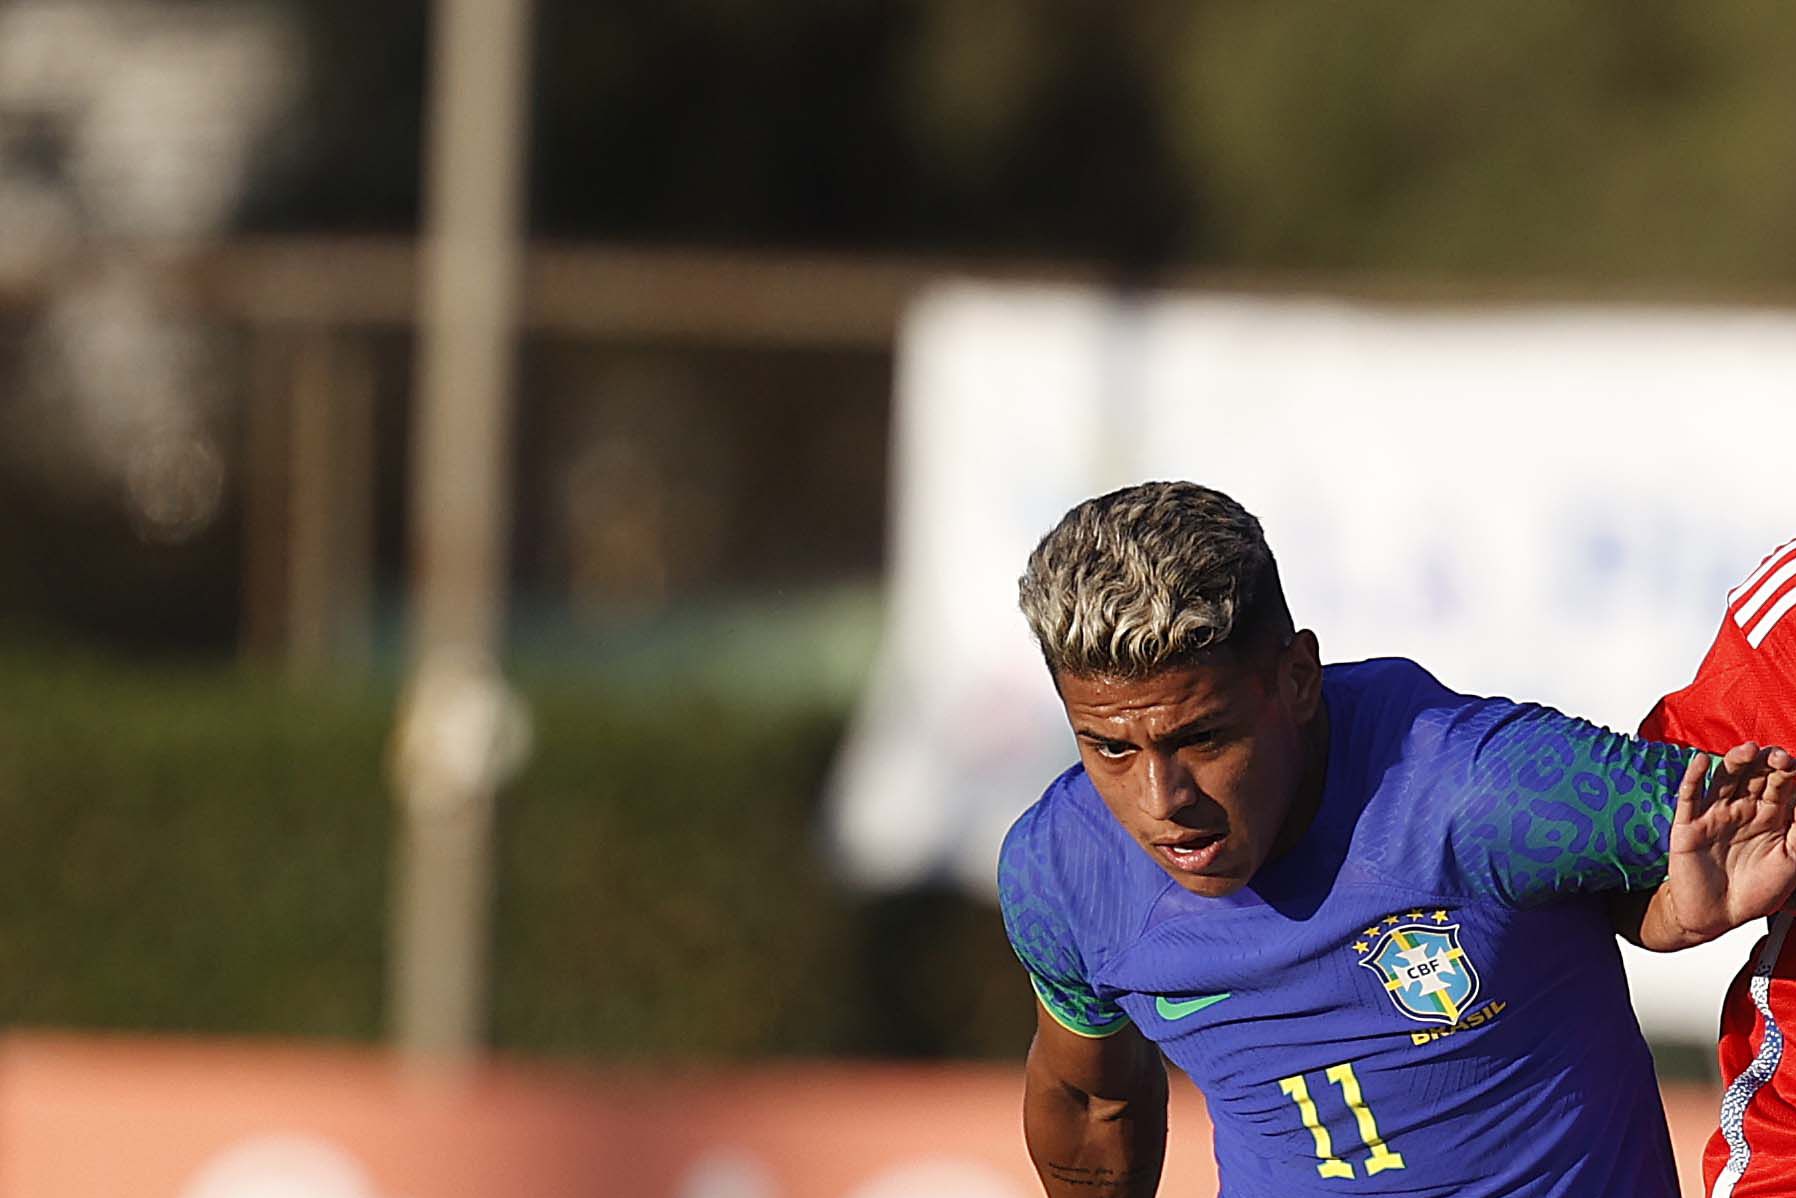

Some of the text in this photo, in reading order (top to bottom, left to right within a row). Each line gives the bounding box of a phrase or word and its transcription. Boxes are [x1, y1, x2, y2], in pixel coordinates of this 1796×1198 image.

[1407, 959, 1440, 980] CBF
[1411, 1000, 1506, 1046] BRASIL
[1278, 1062, 1406, 1180] 11
